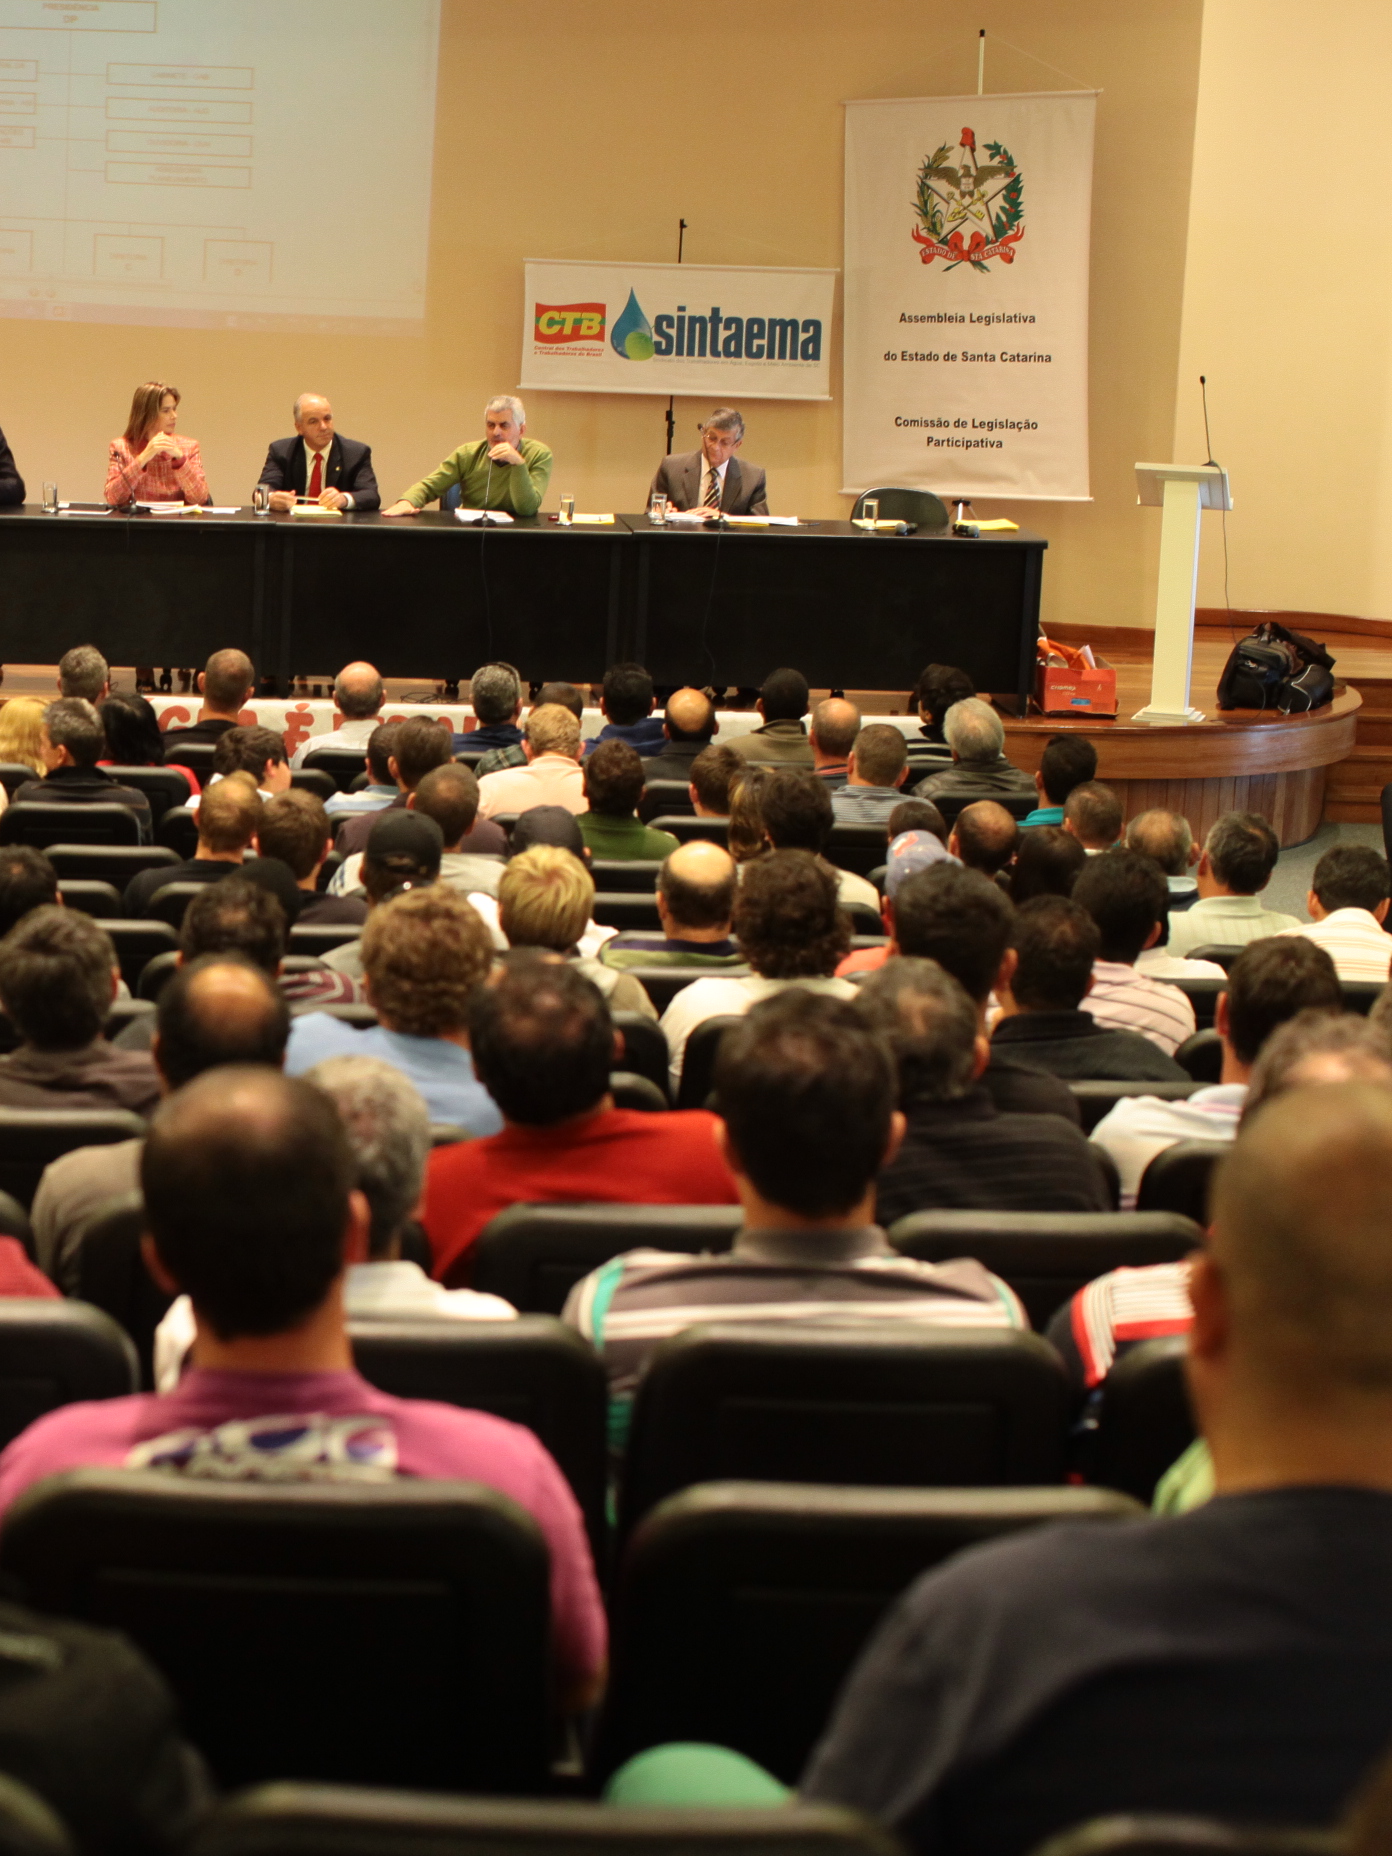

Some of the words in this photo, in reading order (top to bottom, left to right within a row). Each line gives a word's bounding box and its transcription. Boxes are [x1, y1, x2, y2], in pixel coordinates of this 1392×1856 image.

[922, 246, 947, 257] ESTADO
[538, 310, 603, 336] CTB
[898, 312, 966, 325] Assembleia
[969, 312, 1036, 326] Legislativa
[653, 305, 823, 362] sintaema
[883, 350, 898, 362] do
[900, 350, 940, 362] Estado
[942, 351, 958, 362] de
[961, 351, 996, 363] Santa
[1000, 351, 1052, 363] Catarina
[894, 415, 950, 430] Comissão
[953, 416, 968, 429] de
[971, 417, 1039, 433] Legislação
[926, 435, 1003, 450] Participativa
